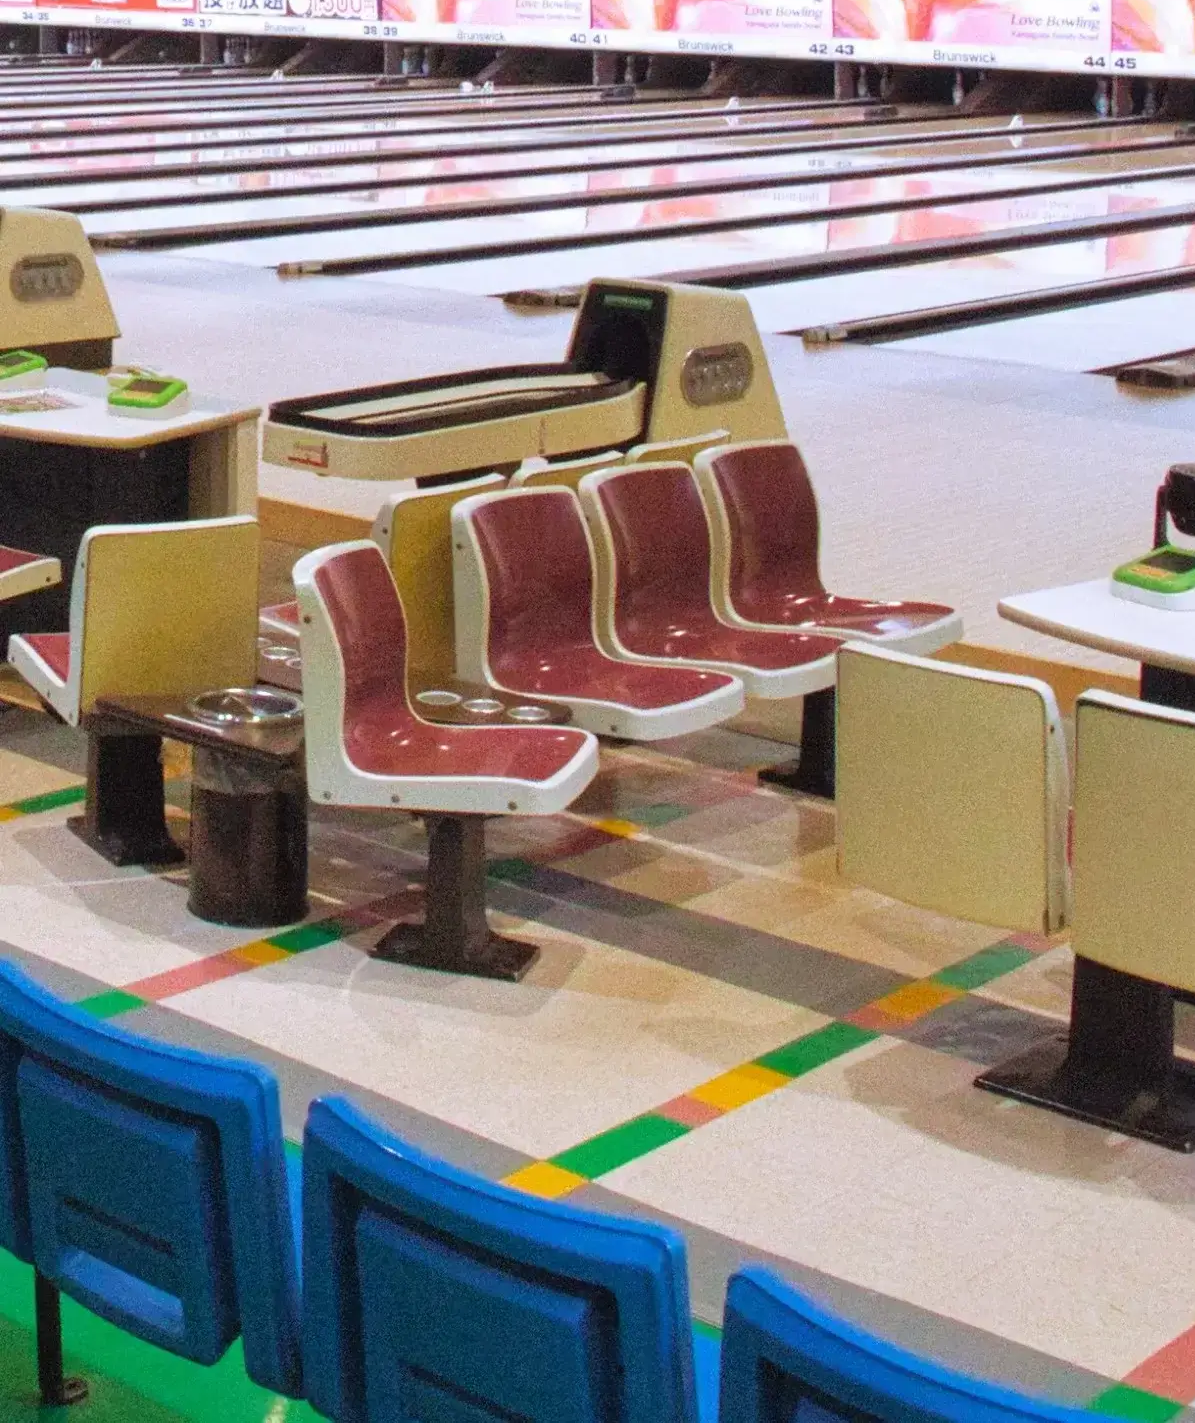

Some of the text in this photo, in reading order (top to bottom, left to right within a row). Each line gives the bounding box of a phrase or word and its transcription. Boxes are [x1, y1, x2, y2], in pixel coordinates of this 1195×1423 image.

[745, 5, 823, 21] Love Bowling
[1011, 14, 1100, 31] Love Bowling
[383, 27, 587, 44] 39 Brunswick 40
[593, 34, 828, 55] 41 Brunswick 42
[835, 45, 1106, 68] 43 Brunswick 44
[1114, 57, 1137, 70] 45
